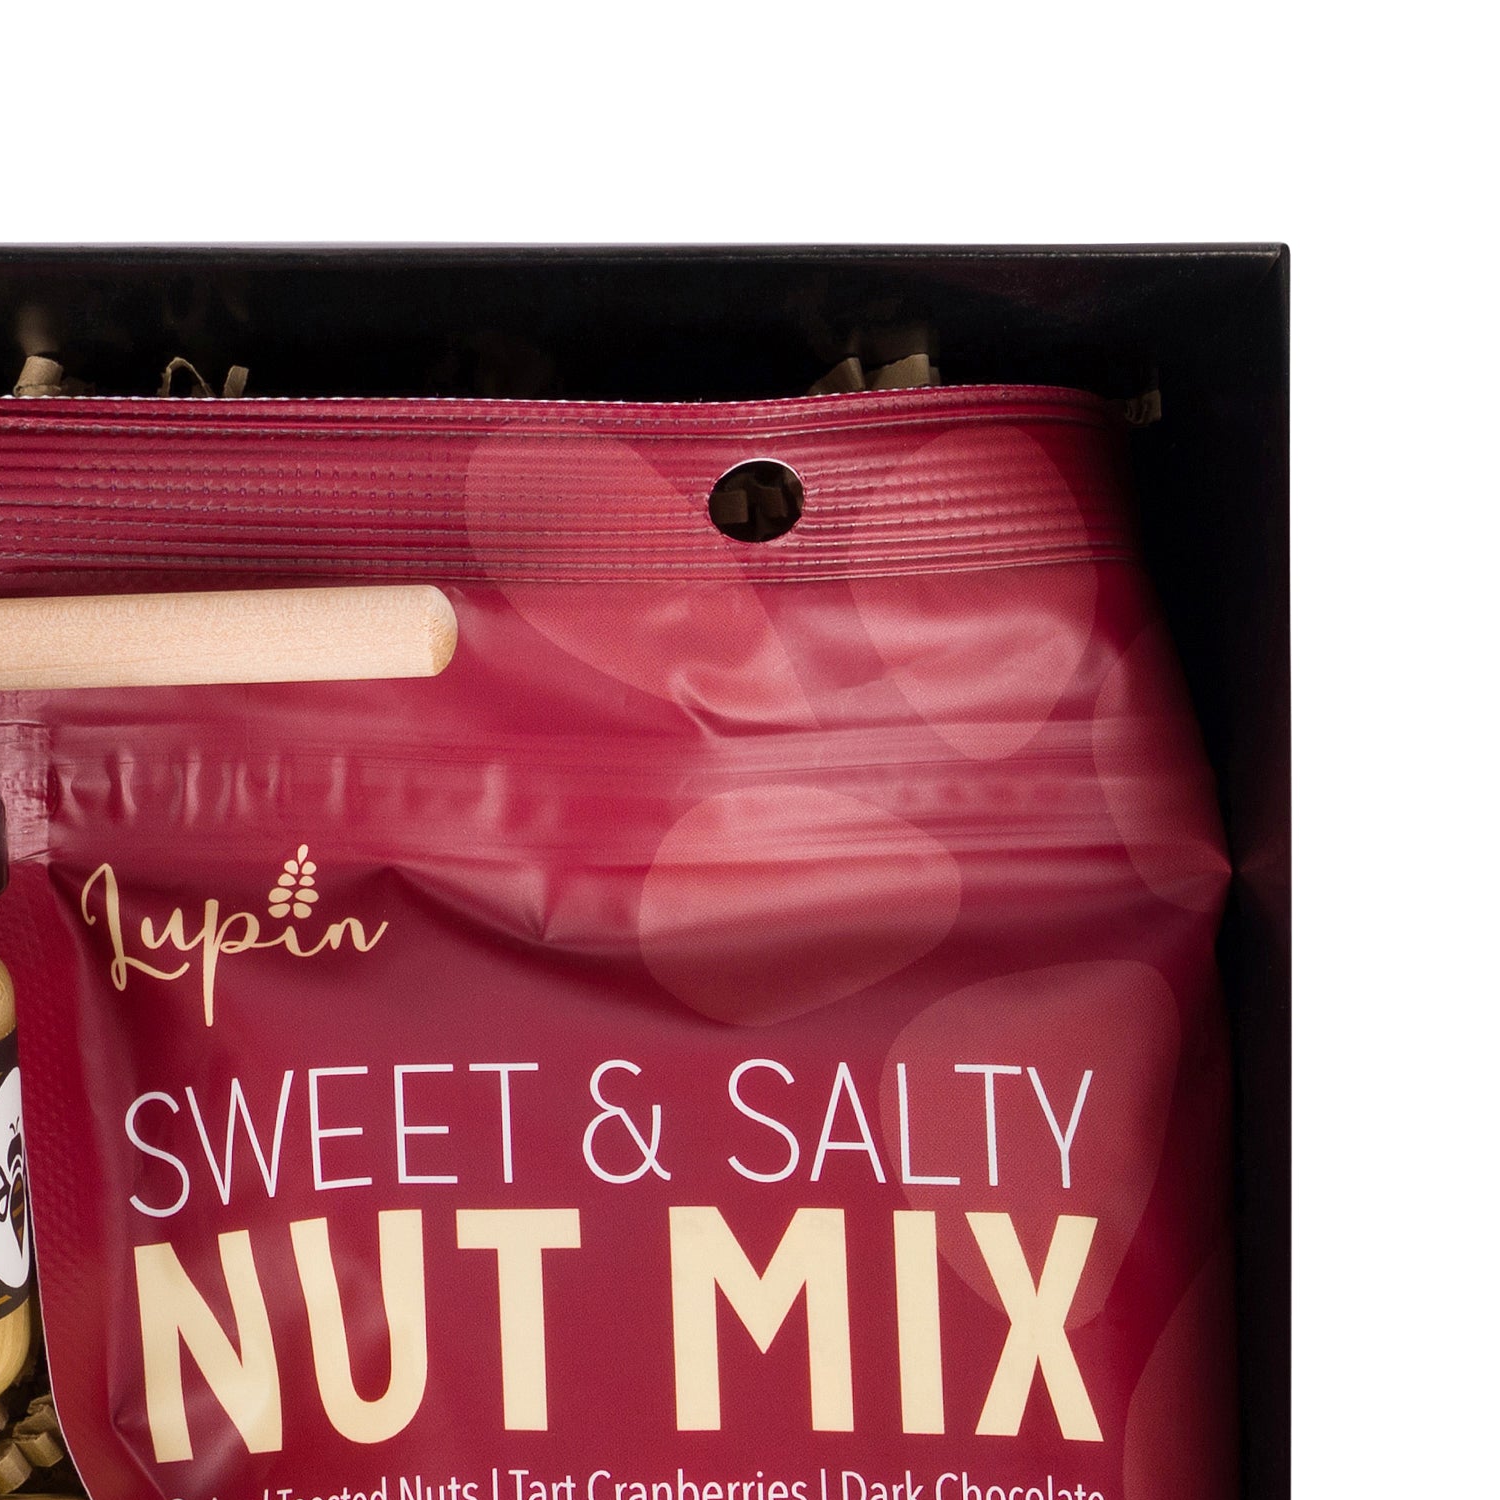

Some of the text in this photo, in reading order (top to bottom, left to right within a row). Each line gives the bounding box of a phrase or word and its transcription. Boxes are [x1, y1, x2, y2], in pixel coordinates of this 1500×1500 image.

[82, 860, 388, 1027] Lupin
[125, 1059, 1093, 1217] SWEET & SALTY
[134, 1206, 1103, 1463] NUT MIX
